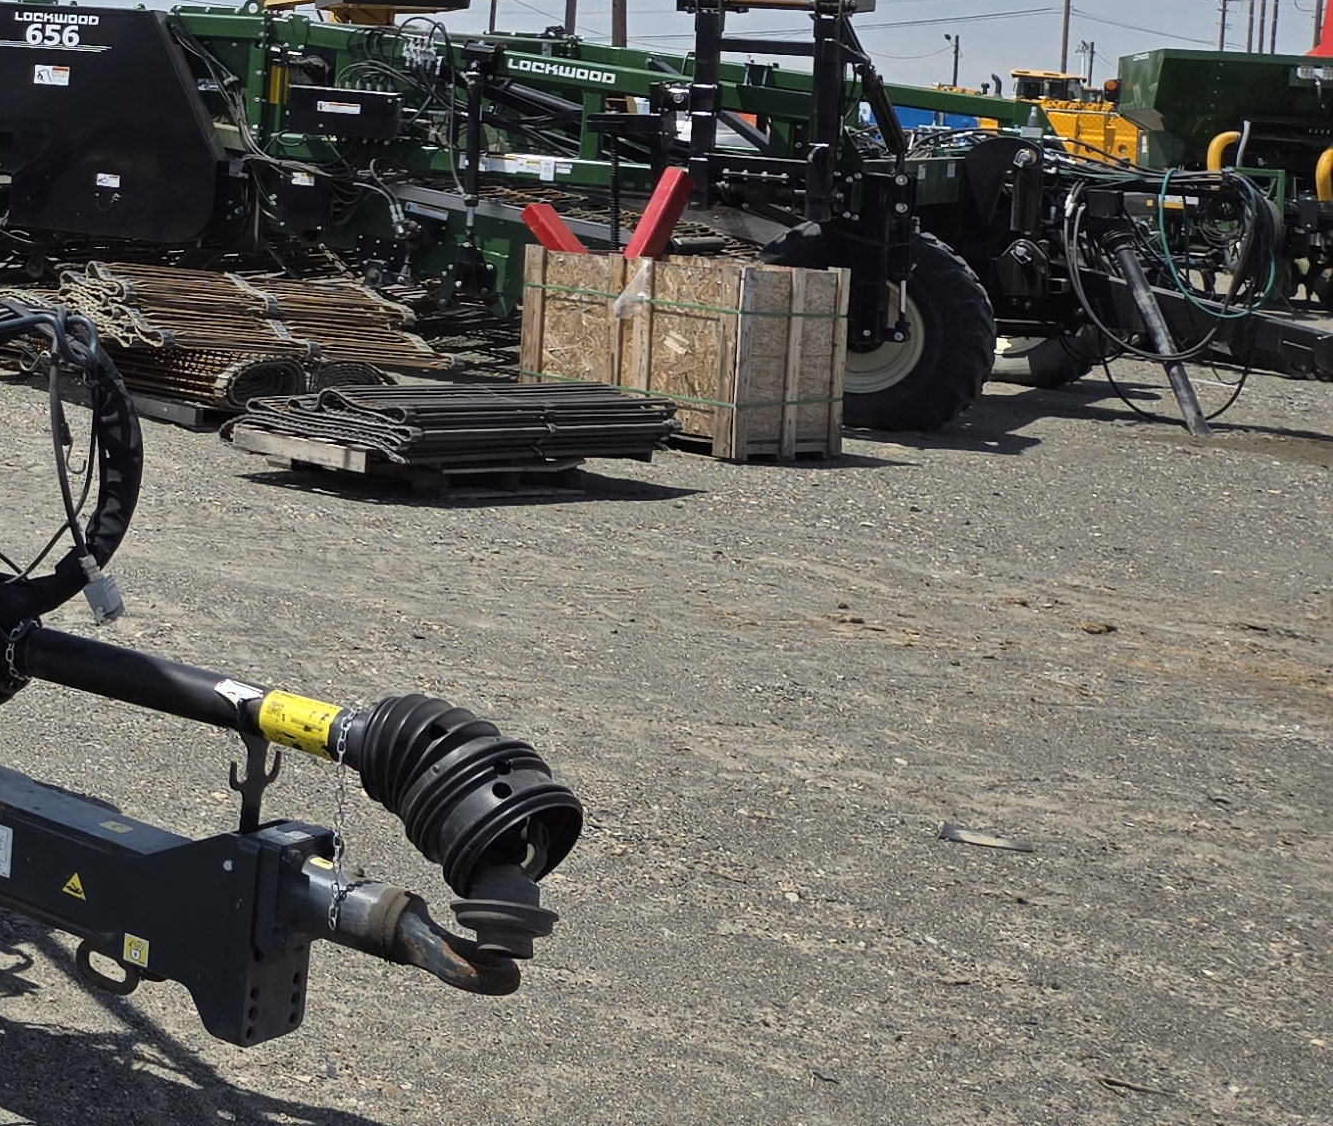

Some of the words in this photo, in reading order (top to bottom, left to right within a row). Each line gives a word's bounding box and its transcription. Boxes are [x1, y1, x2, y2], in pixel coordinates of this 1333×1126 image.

[14, 11, 99, 25] LOCKWOOD
[25, 23, 80, 47] 656
[507, 58, 616, 84] LOCKWOOD
